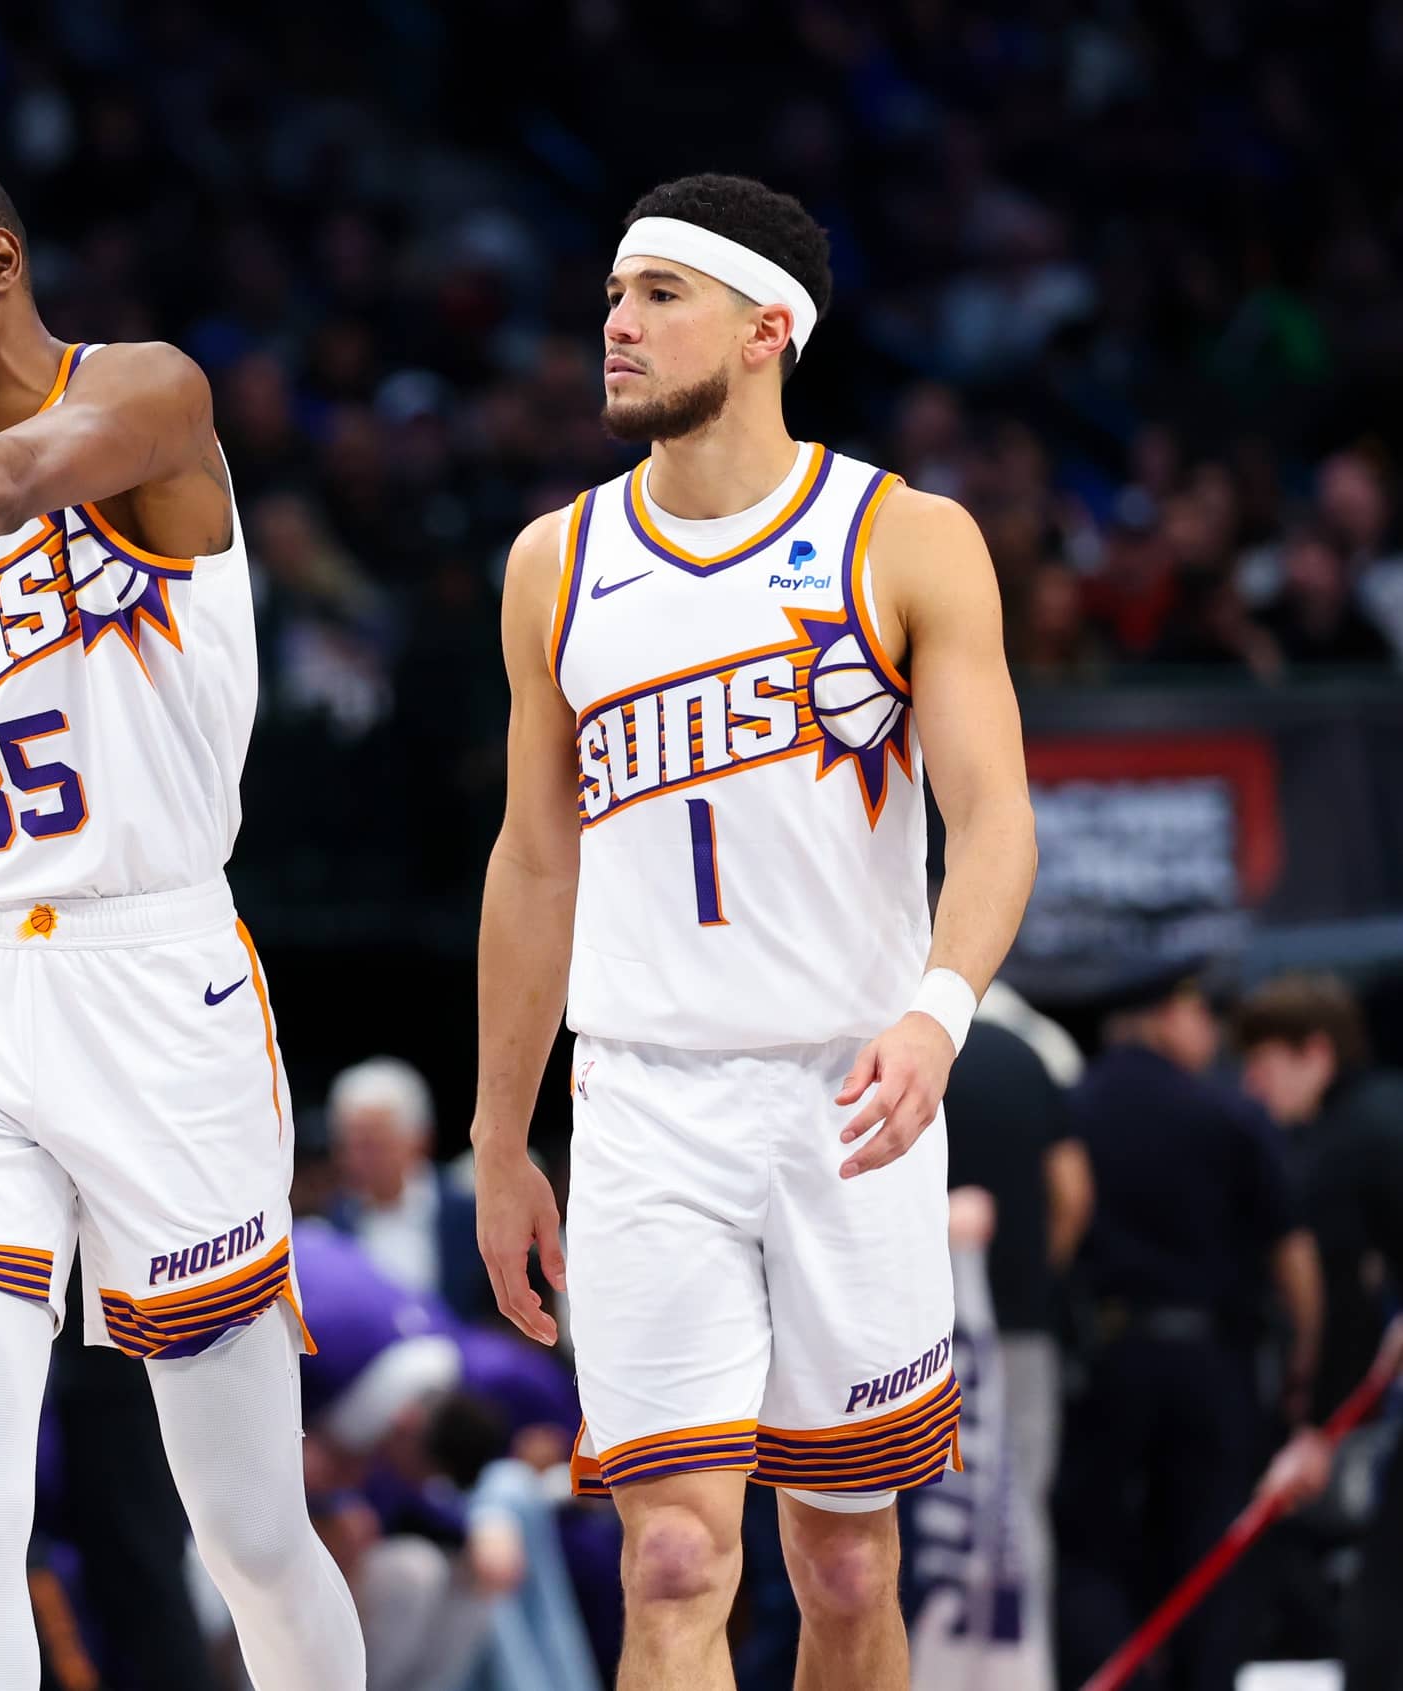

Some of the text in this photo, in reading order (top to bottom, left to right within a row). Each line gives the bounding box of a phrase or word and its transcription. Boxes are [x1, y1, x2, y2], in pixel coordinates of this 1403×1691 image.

[768, 575, 831, 590] PayPal
[581, 656, 798, 820] SUNS
[684, 798, 731, 927] 1
[149, 1210, 265, 1286] PHOENIX
[844, 1330, 951, 1413] PHOENIX
